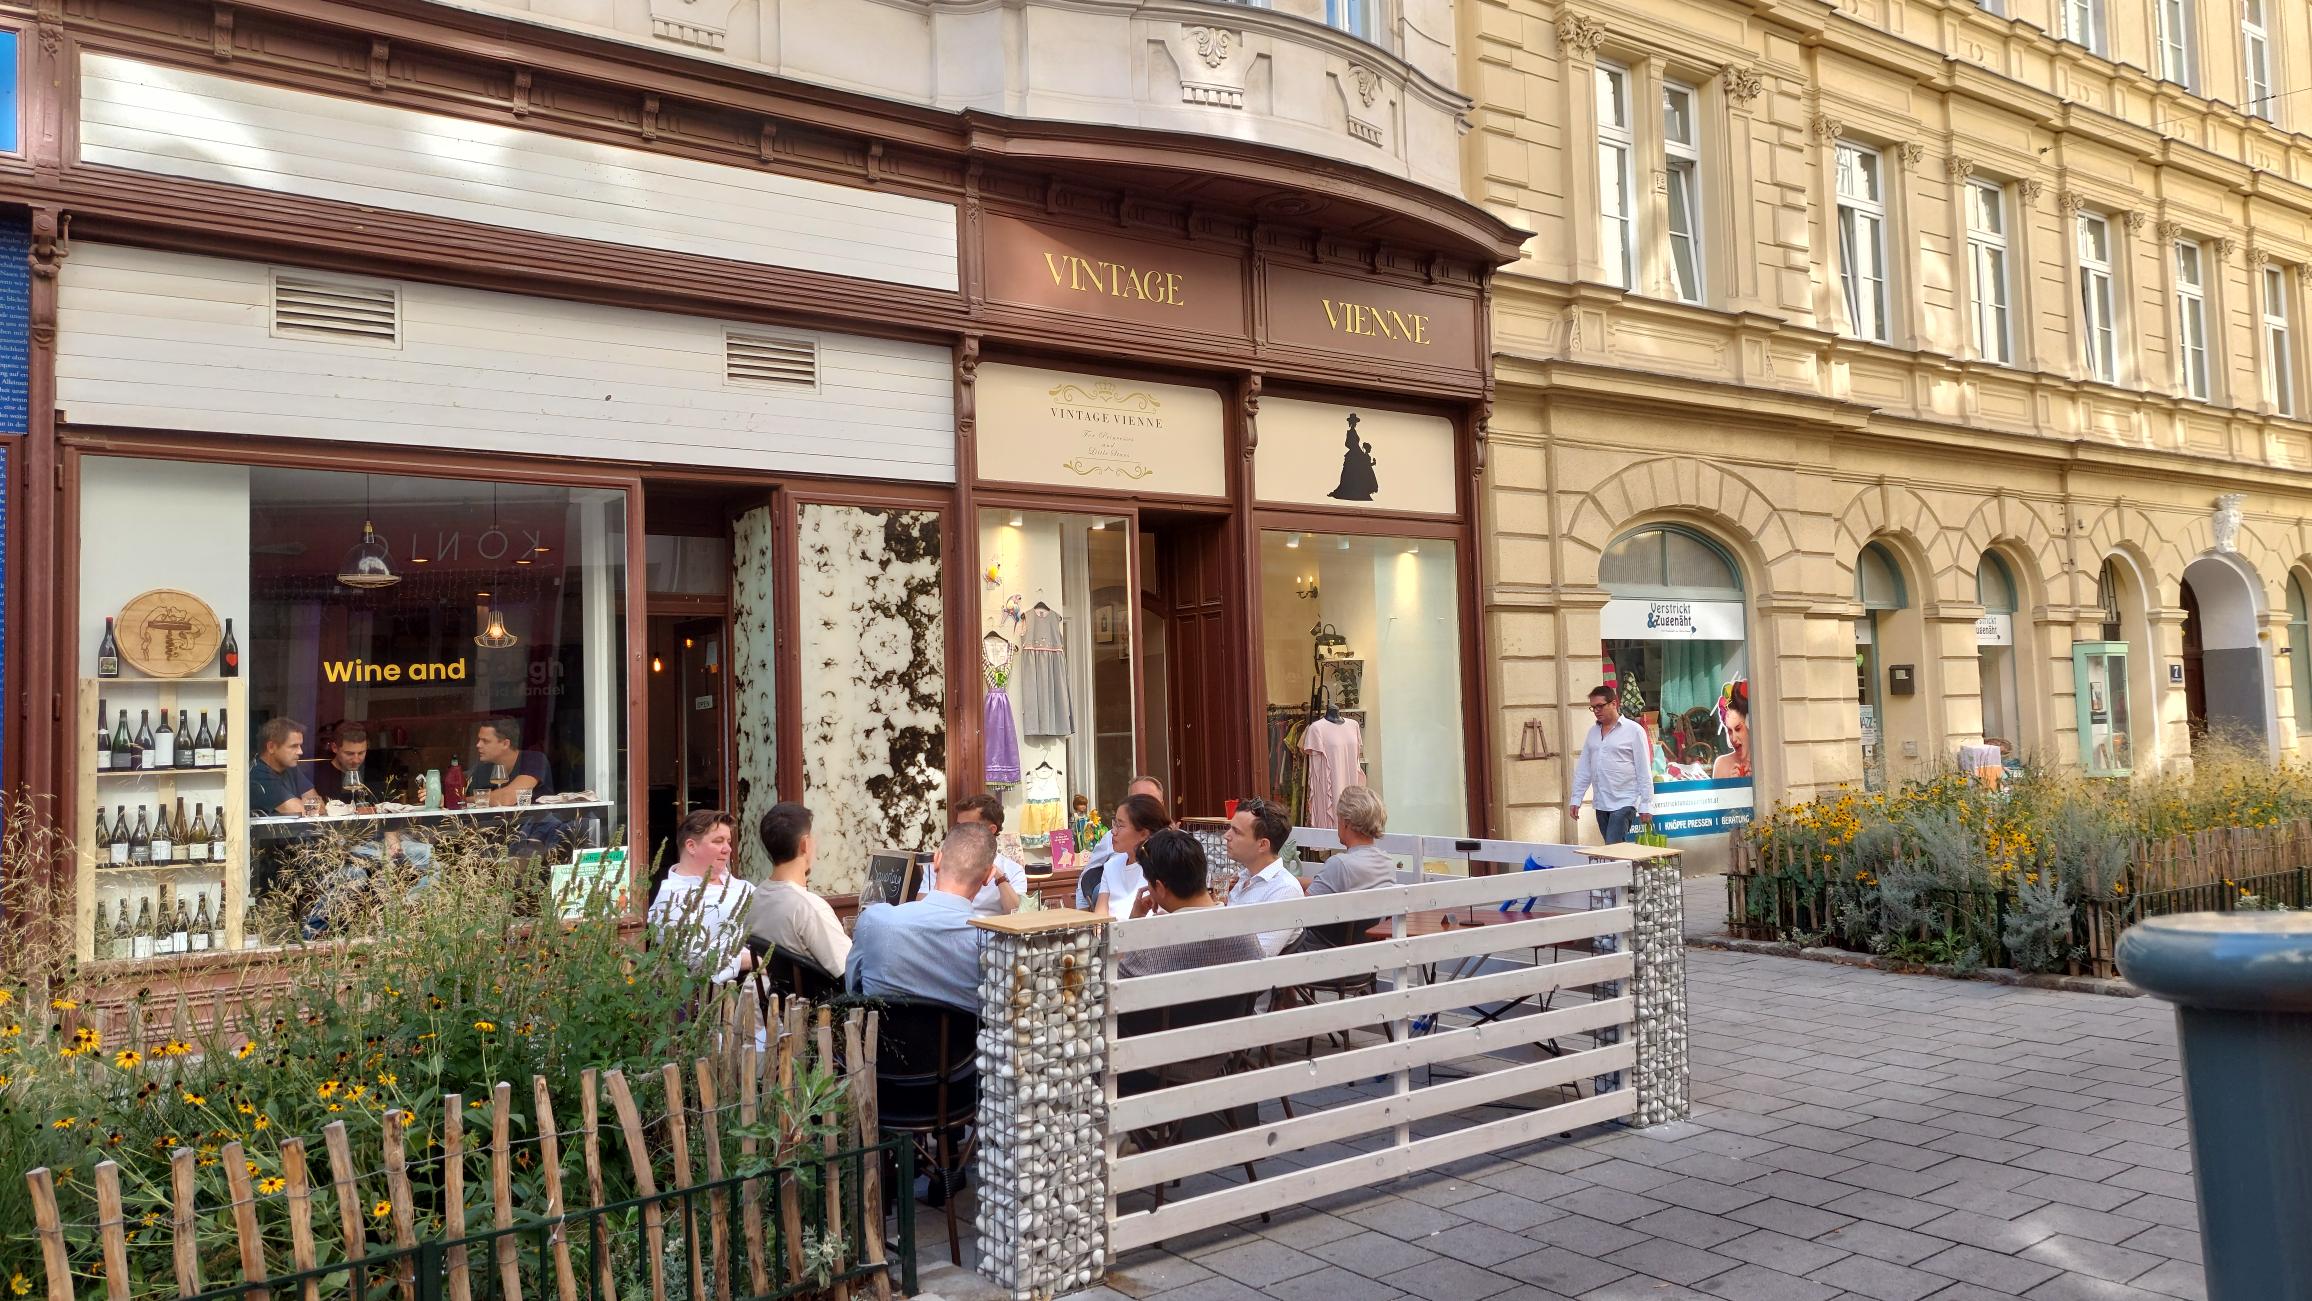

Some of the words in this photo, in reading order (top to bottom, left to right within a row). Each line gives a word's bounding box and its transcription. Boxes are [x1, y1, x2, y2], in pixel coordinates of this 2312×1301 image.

[1042, 251, 1185, 308] VINTAGE
[1320, 298, 1431, 346] VIENNE
[1050, 407, 1110, 423] VINTAGE
[1114, 414, 1163, 429] VIENNE
[1650, 602, 1691, 614] Verstrickt
[323, 658, 401, 683] Wine
[408, 658, 466, 682] and
[1664, 819, 1688, 831] KNÖPFE
[1687, 816, 1713, 829] PRESSEN
[1721, 814, 1750, 825] BERATUNG
